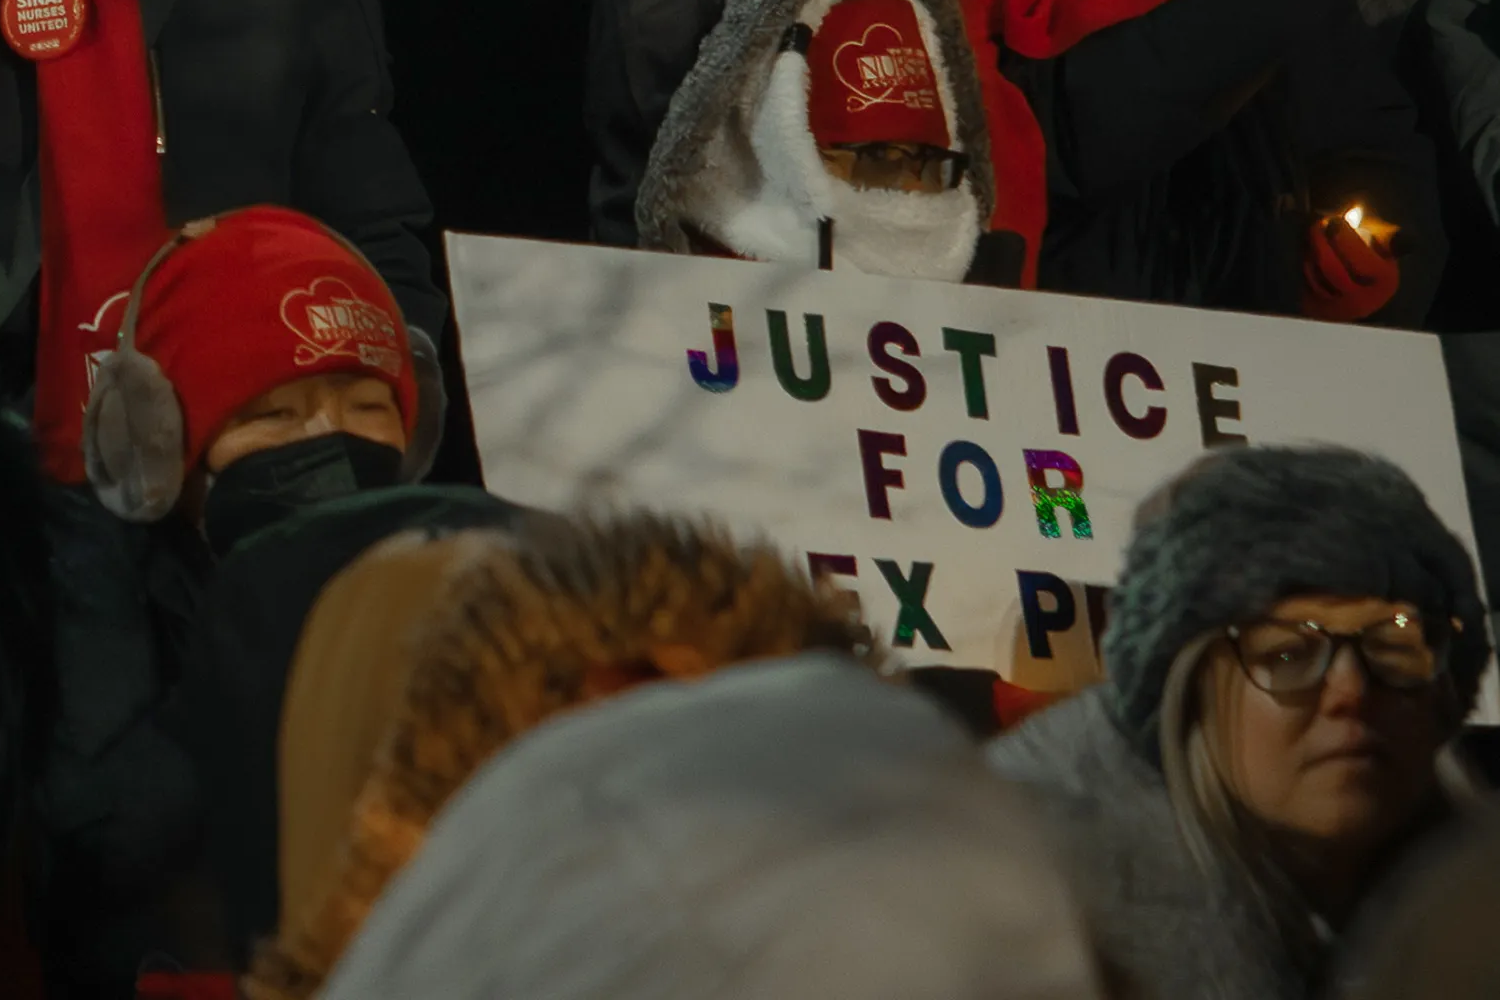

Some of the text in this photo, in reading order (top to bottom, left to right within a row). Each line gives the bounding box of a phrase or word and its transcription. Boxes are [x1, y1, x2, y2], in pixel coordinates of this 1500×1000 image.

[17, 5, 66, 21] NURSES
[18, 18, 68, 34] UNITED!
[687, 302, 1248, 448] JUSTICE
[857, 428, 1094, 540] FOR
[1016, 568, 1115, 668] P
